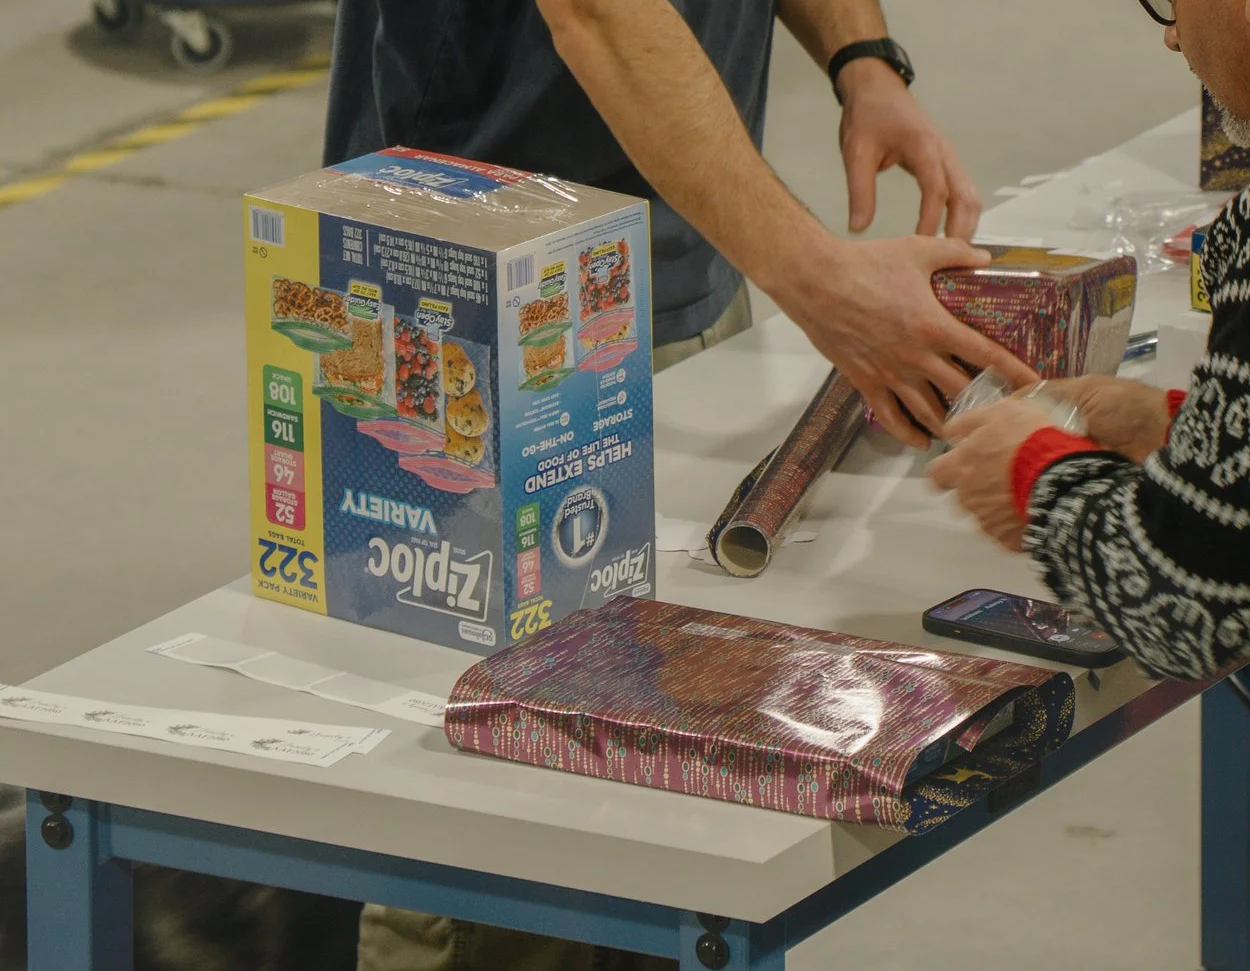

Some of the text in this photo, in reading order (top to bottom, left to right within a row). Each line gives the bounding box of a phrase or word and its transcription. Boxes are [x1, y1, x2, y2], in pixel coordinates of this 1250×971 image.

[269, 381, 296, 405] 108
[267, 408, 298, 422] SANDWICH
[593, 409, 632, 431] STORAGE
[272, 420, 295, 443] 116
[522, 431, 574, 457] ON-THE-GO
[538, 434, 619, 470] THE LIFE OF FOOD
[273, 464, 294, 485] 46
[524, 441, 632, 493] HELPS EXTEND
[275, 503, 294, 525] 52
[340, 489, 436, 534] VARIETY
[520, 512, 535, 526] 108
[564, 499, 594, 518] Trusted
[268, 531, 304, 546] TOTAL BAGS
[521, 534, 535, 548] 116
[258, 538, 318, 590] 322
[368, 537, 480, 611] Ziploc
[522, 560, 534, 573] 46
[590, 550, 644, 591] Ziploc
[258, 579, 318, 603] VARIETY PACK
[523, 581, 534, 595] 52
[510, 600, 552, 640] 322
